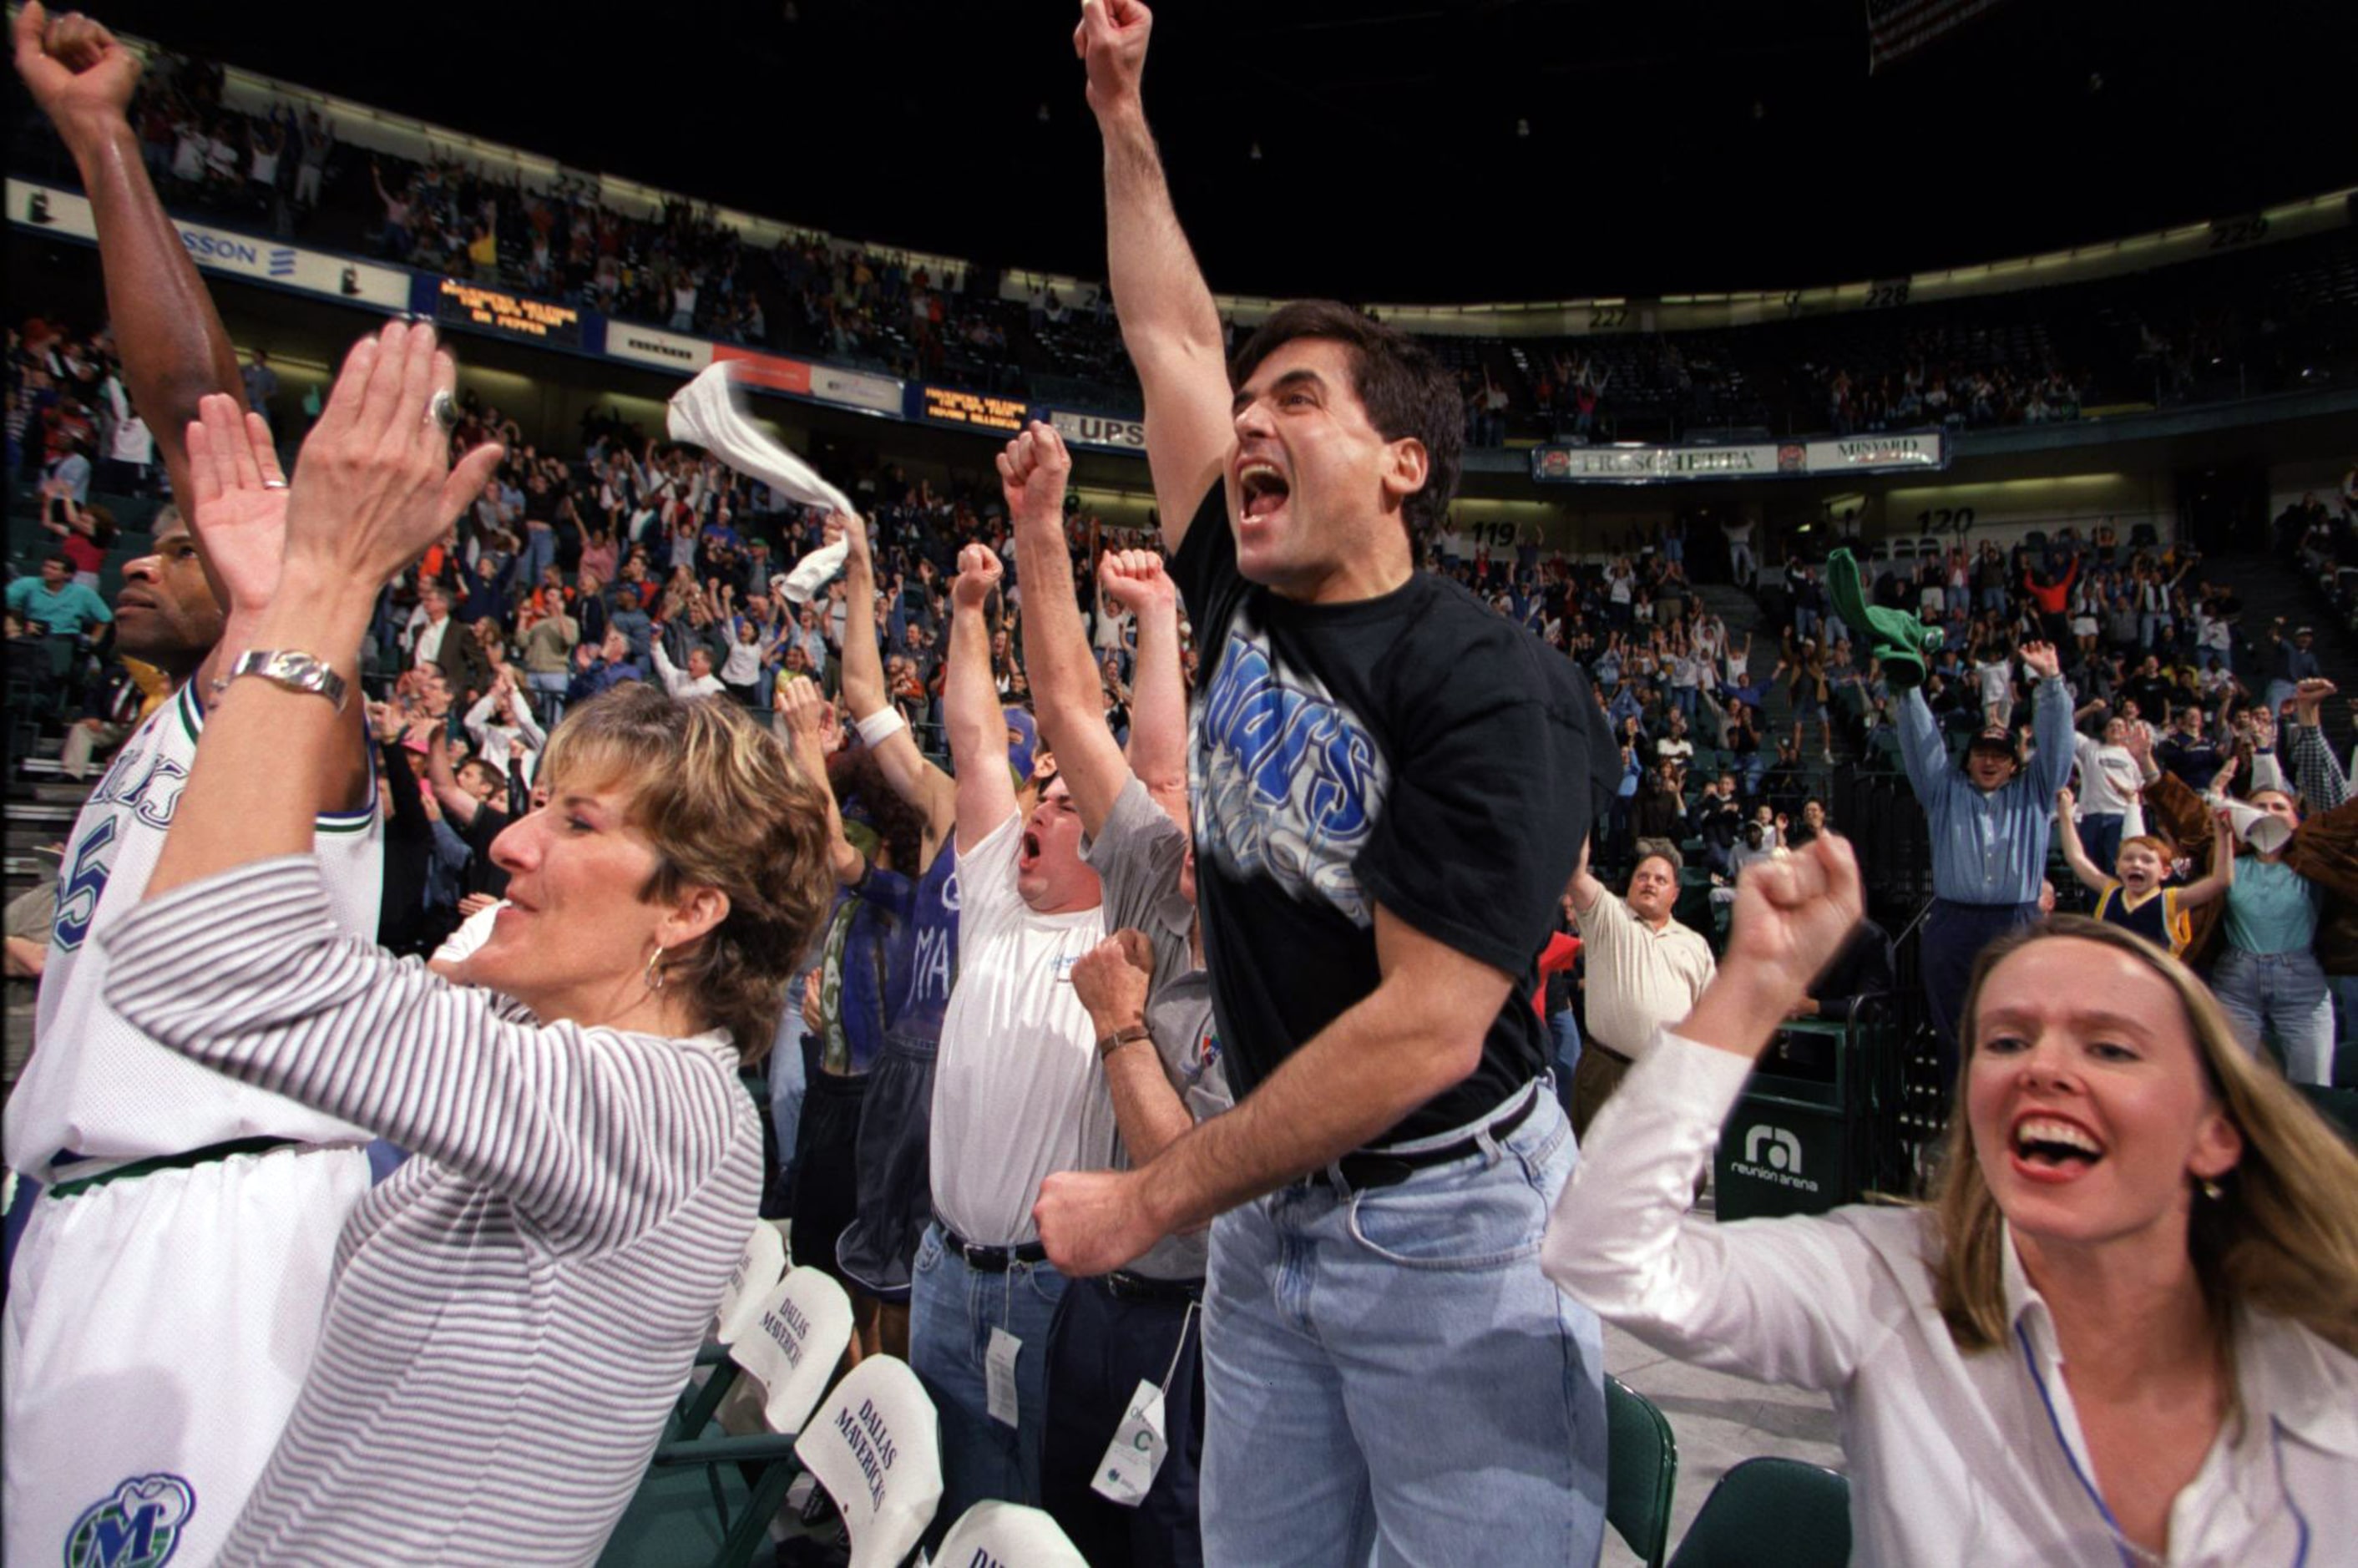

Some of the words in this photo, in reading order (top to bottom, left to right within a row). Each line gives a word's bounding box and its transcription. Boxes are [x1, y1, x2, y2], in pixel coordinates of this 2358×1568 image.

[1865, 286, 1909, 306] 228
[1590, 310, 1629, 328] 227
[1080, 417, 1144, 446] UPS
[1838, 438, 1919, 457] MINYARD
[1471, 521, 1516, 547] 119
[1917, 506, 1976, 535] 120
[1731, 1161, 1778, 1182] reunion
[1779, 1173, 1819, 1192] arena
[779, 1297, 810, 1340] DALLAS
[858, 1399, 897, 1470] DALLAS
[1134, 1429, 1153, 1452] C
[835, 1406, 886, 1513] MAVERICKS
